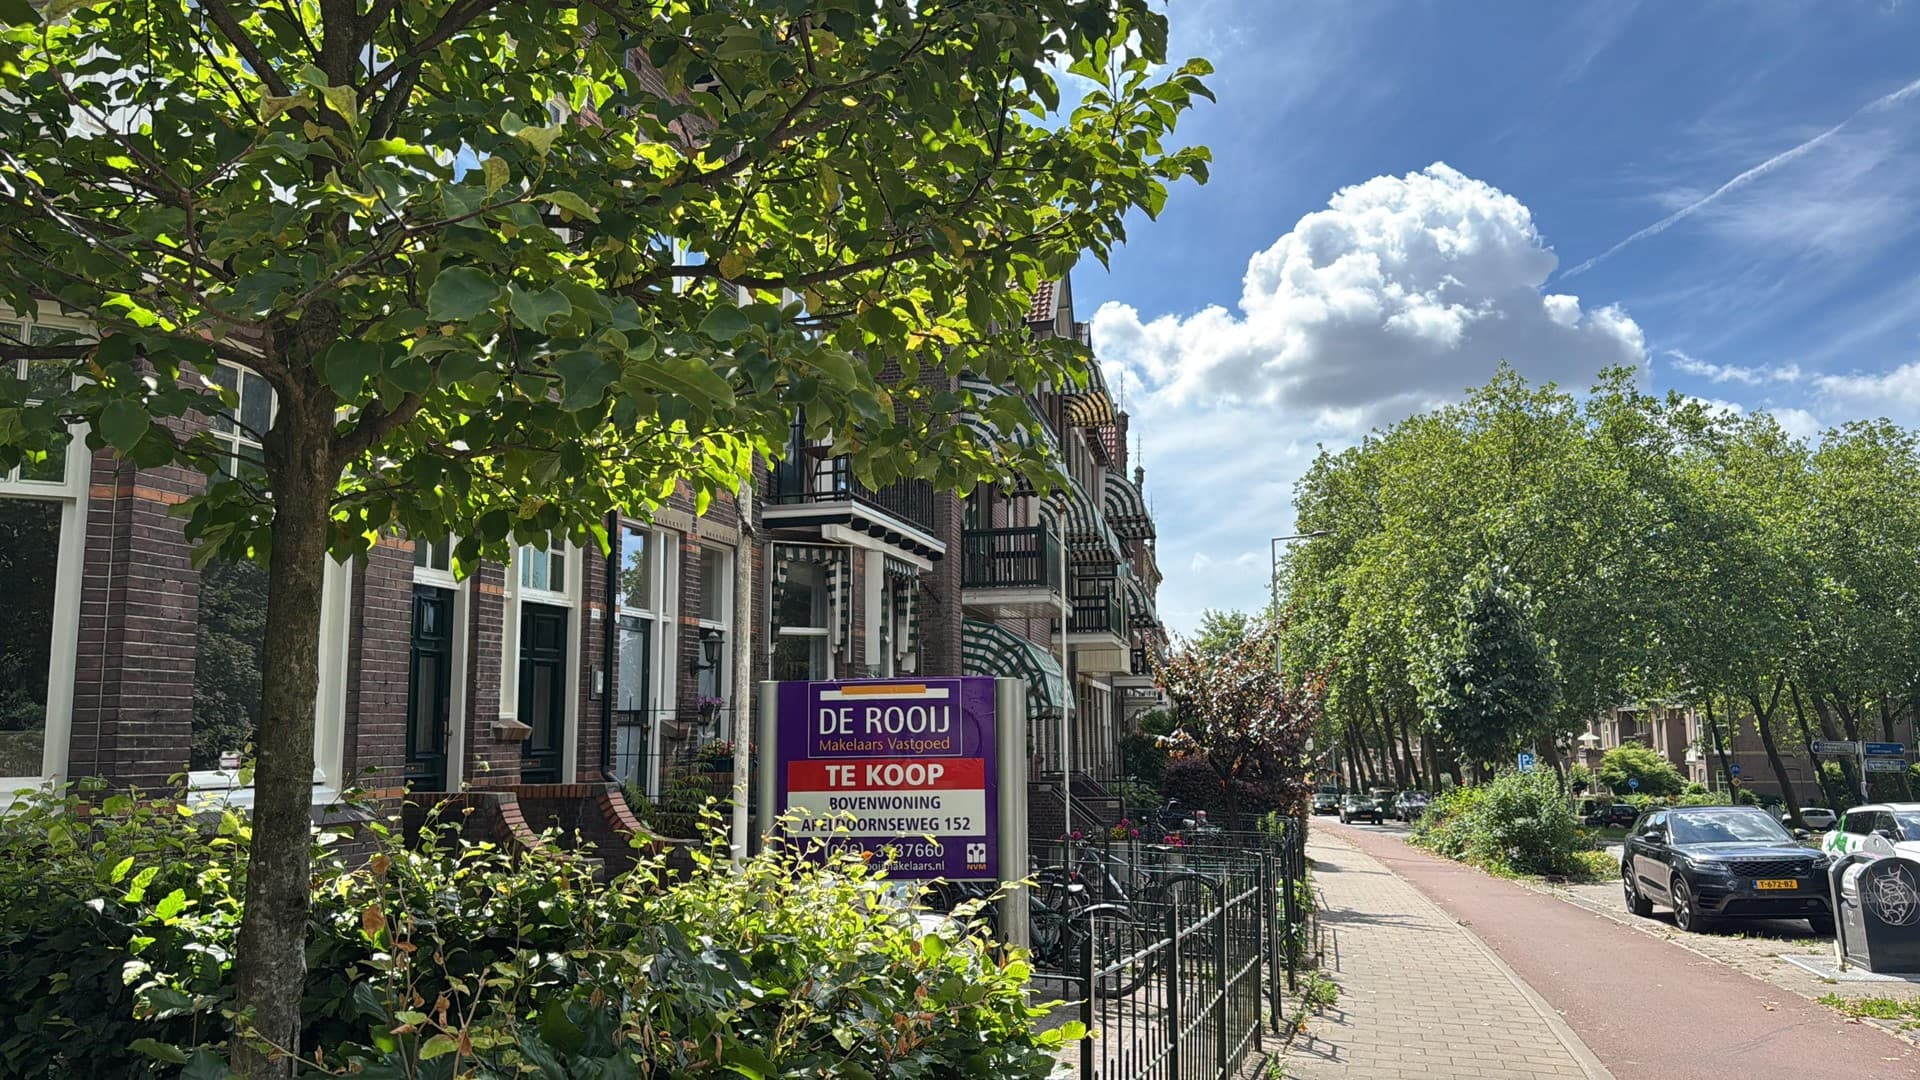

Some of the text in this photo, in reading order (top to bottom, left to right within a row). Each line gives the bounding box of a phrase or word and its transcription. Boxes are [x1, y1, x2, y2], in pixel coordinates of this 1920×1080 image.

[819, 705, 950, 735] DE ROOIJ
[819, 737, 950, 754] Makelaars Vastgoed
[825, 763, 945, 787] TE KOOP
[829, 796, 941, 810] BOVENWONING
[945, 817, 971, 831] 152
[876, 843, 945, 858] 337660
